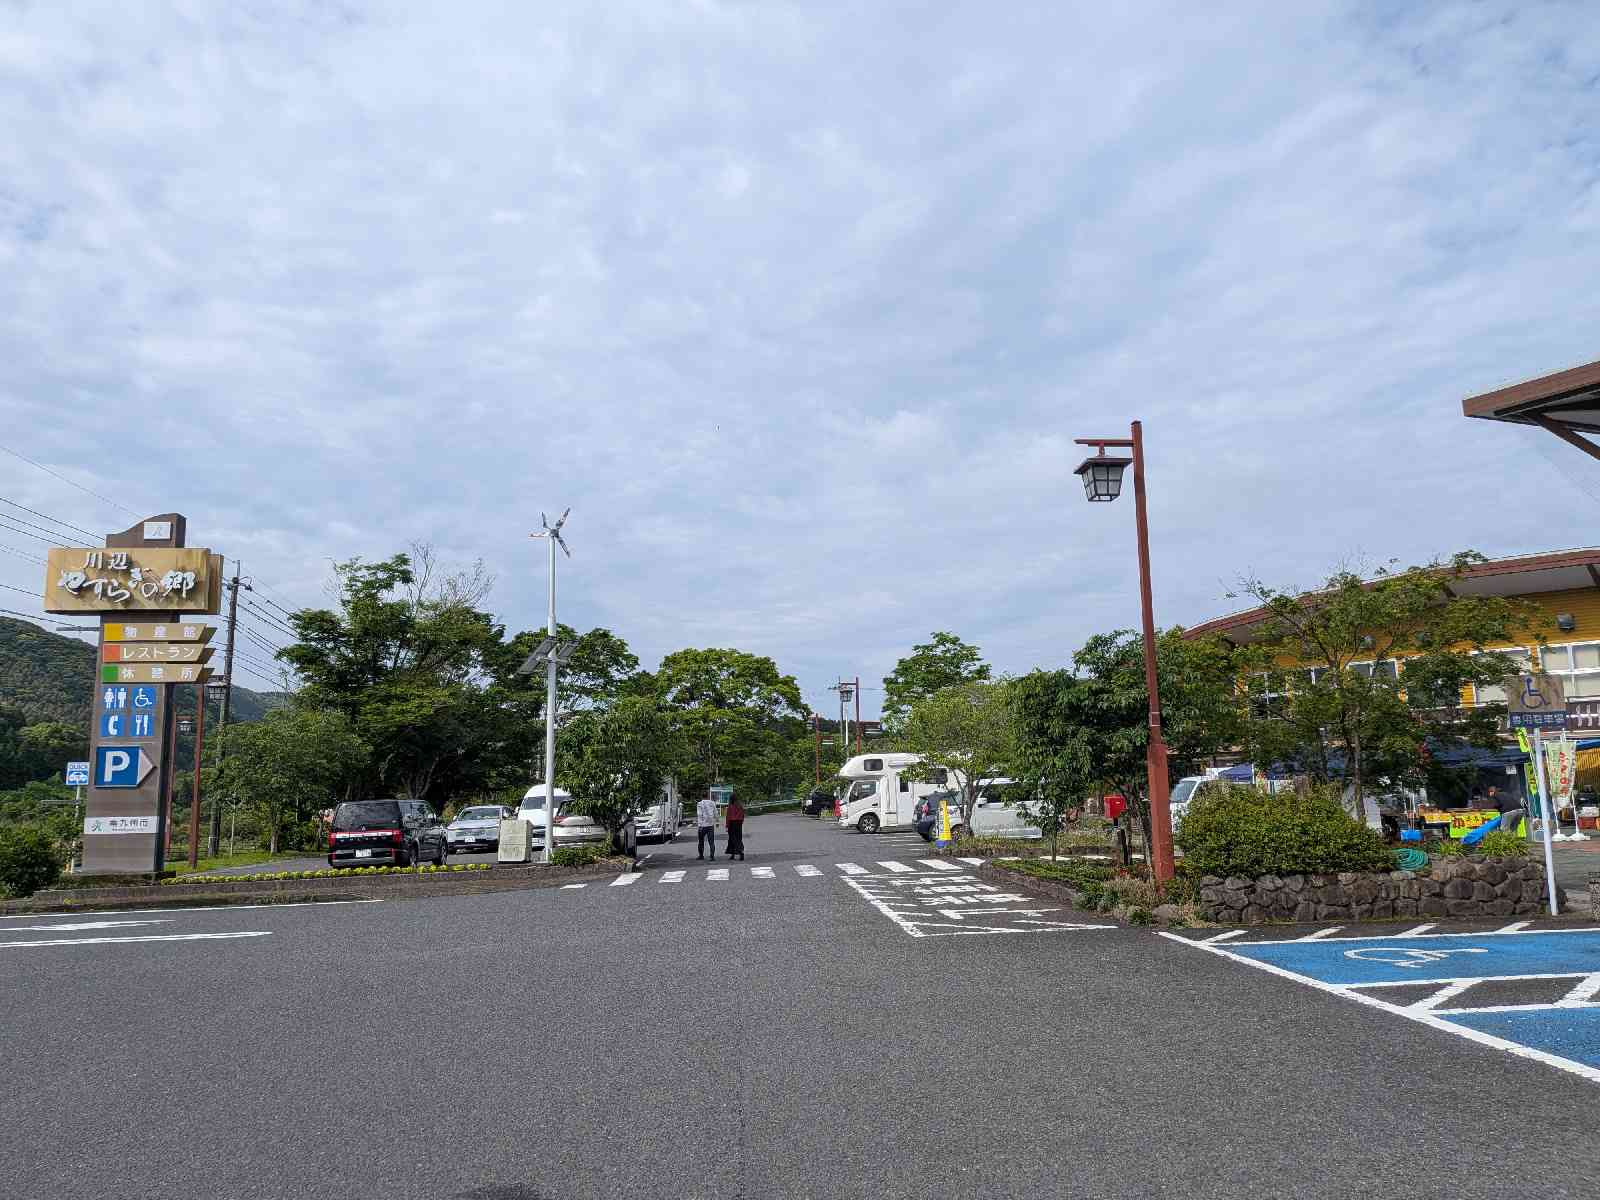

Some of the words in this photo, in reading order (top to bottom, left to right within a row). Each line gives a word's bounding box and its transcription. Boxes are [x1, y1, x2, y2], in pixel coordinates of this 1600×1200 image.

[83, 551, 129, 570] 川辺
[123, 646, 195, 659] レストラン
[103, 750, 131, 782] P
